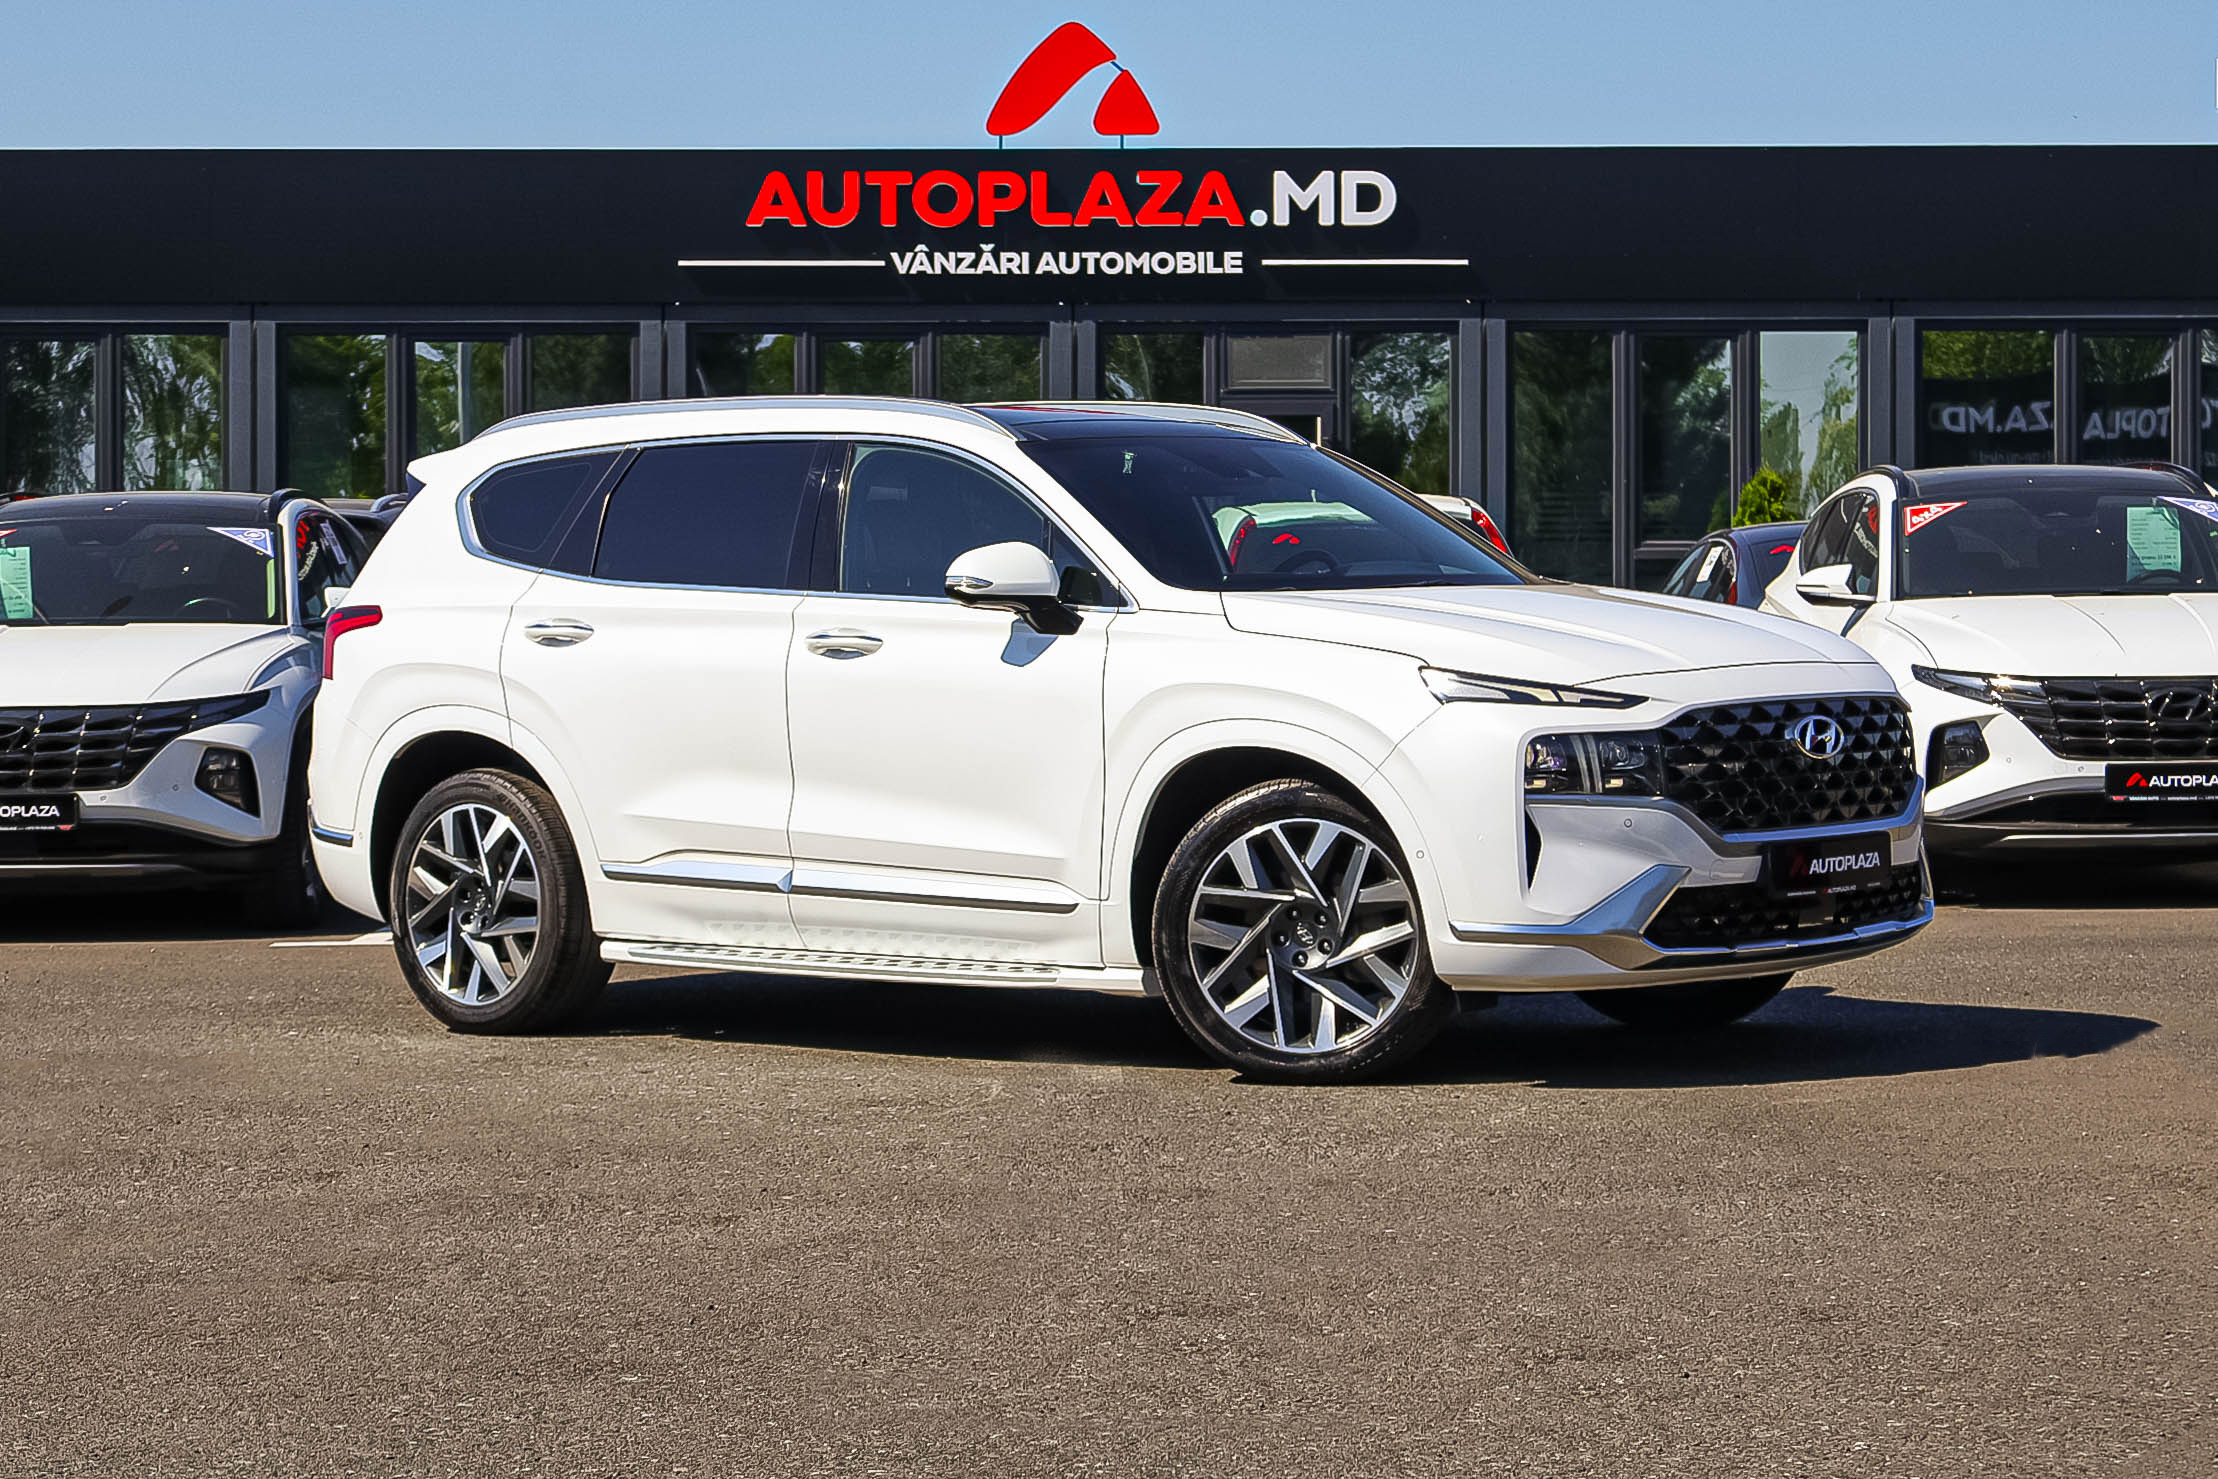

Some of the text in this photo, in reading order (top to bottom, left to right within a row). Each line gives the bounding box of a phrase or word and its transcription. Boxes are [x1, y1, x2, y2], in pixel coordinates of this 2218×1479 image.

[745, 170, 1397, 228] AUTOPLAZA.MD
[890, 243, 1244, 275] VÂNZĂRI AUTOMOBILE
[1808, 851, 1881, 875] AUTOPLAZA
